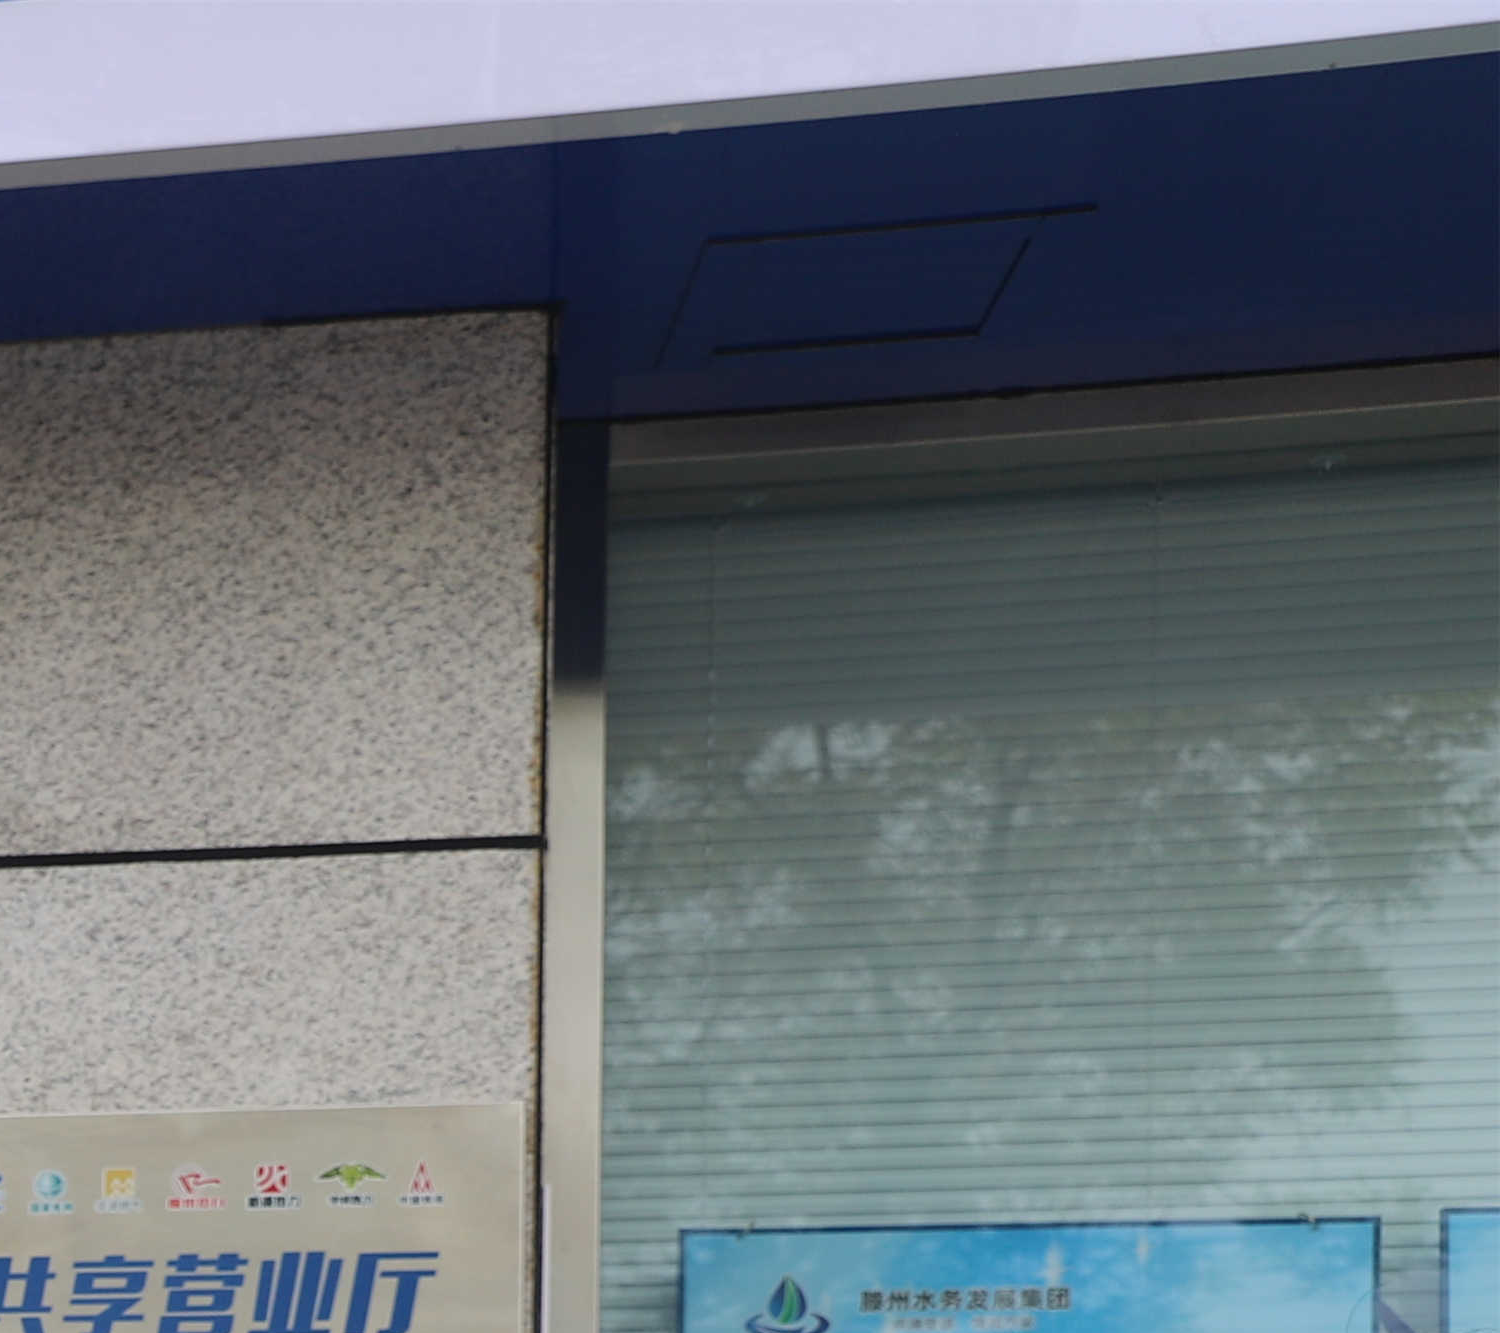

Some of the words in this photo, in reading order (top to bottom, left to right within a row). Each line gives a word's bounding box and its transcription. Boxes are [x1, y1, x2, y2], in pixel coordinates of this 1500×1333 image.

[859, 1287, 1071, 1313] 滕州水务发展集团
